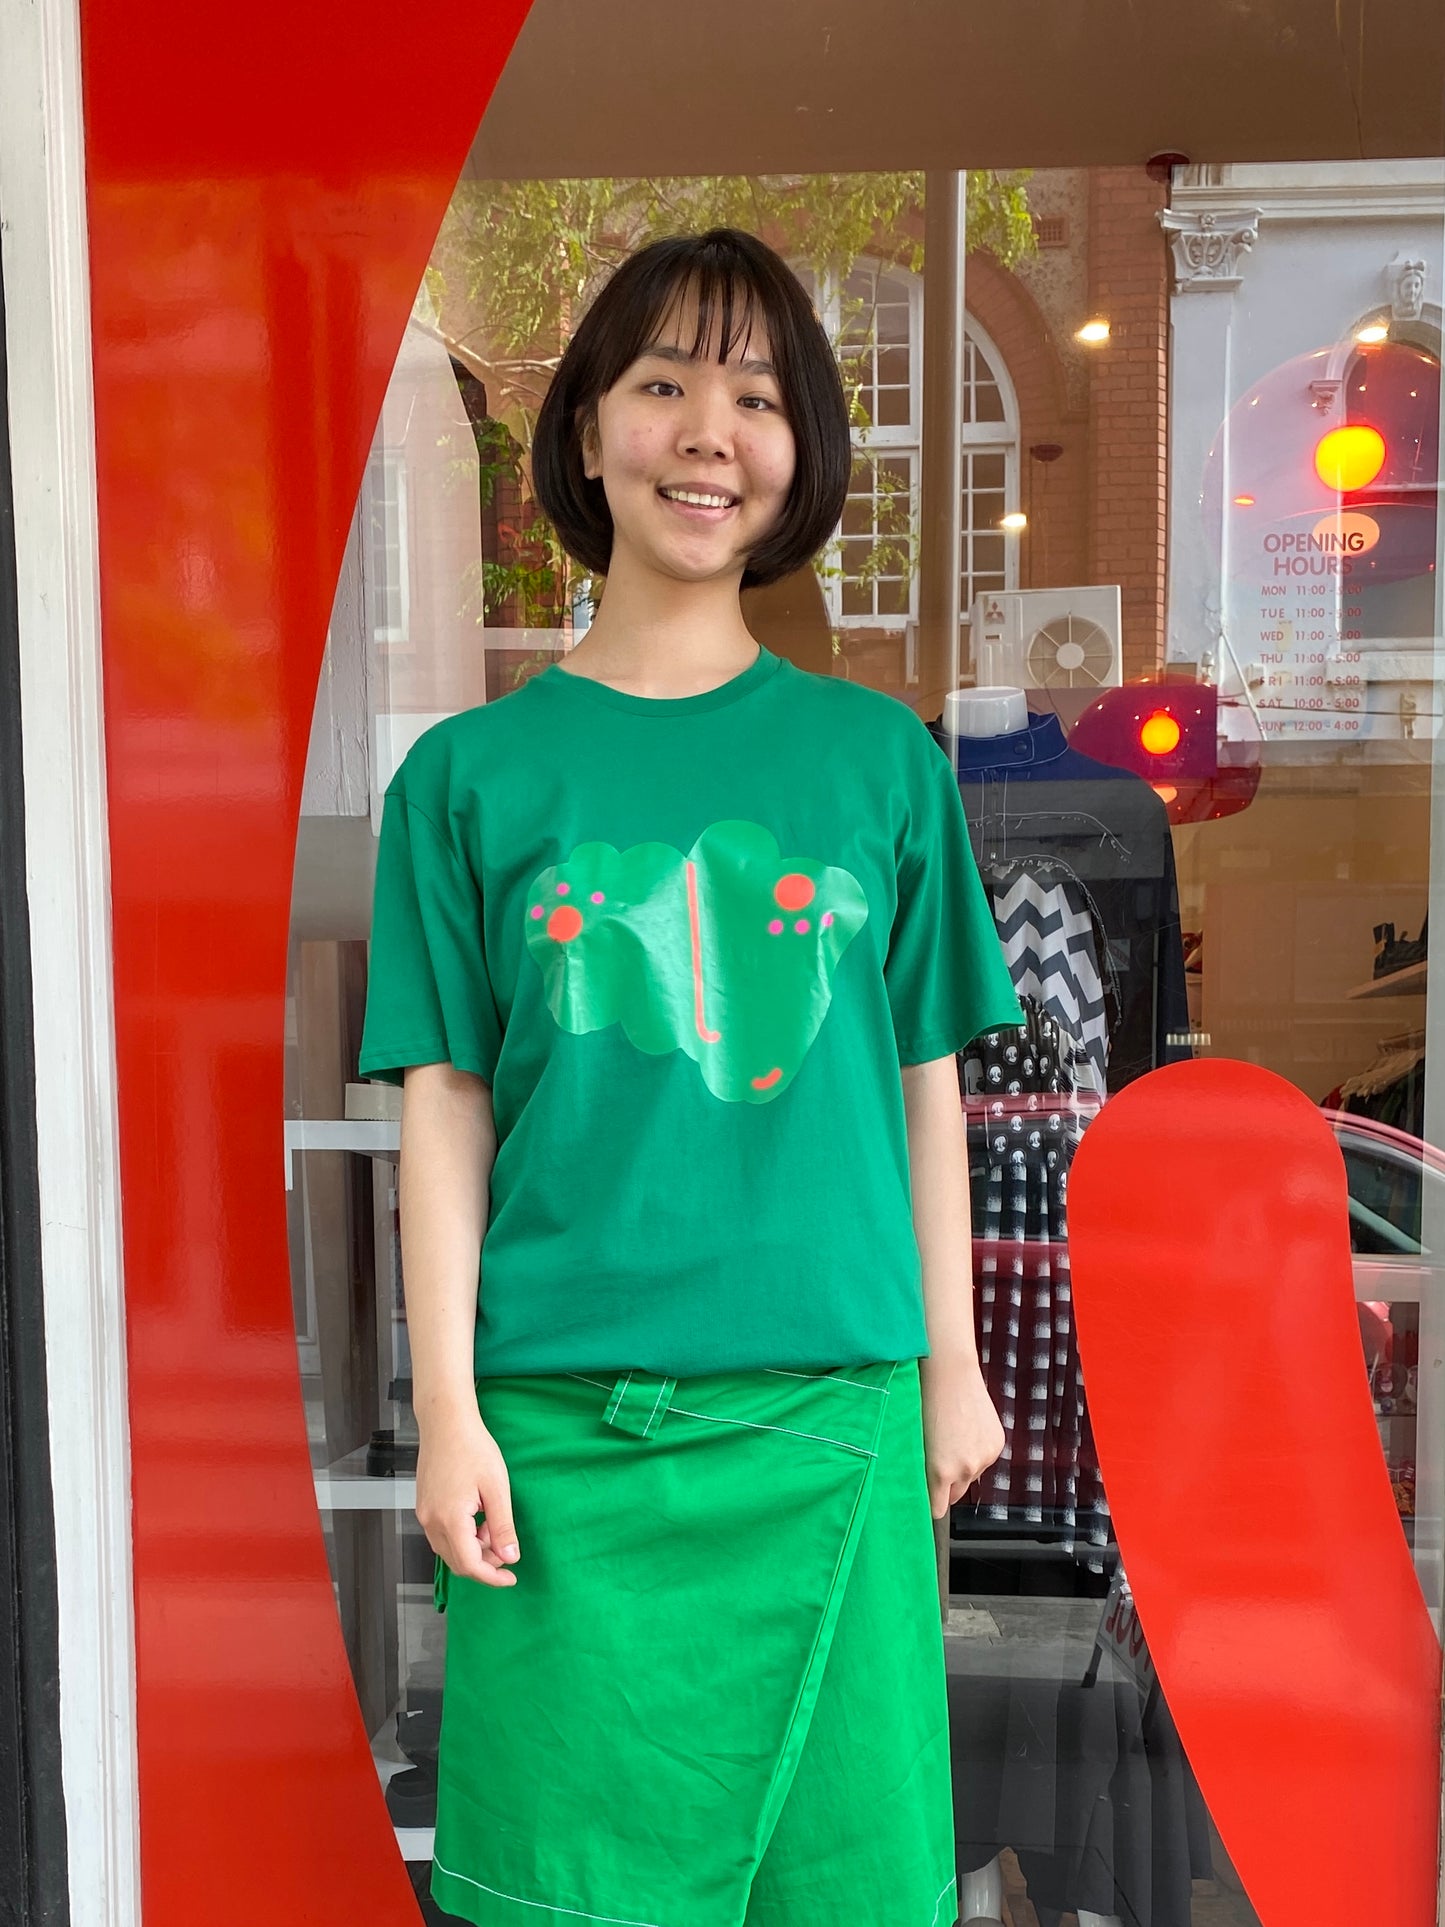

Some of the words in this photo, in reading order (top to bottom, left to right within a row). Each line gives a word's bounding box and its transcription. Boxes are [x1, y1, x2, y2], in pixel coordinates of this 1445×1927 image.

[1263, 532, 1364, 553] OPENING
[1273, 555, 1353, 576] HOURS
[1261, 585, 1287, 596] MON
[1296, 585, 1326, 596] 11:00
[1260, 608, 1285, 618] TUE
[1296, 608, 1325, 618] 11:00
[1260, 631, 1284, 641] WED
[1295, 631, 1325, 641] 11:00
[1260, 653, 1283, 664] THU
[1295, 653, 1324, 663] 11:00
[1259, 676, 1282, 686] FRI
[1294, 676, 1324, 686] 11:00
[1259, 699, 1283, 709] SAT
[1294, 699, 1323, 709] 10:00
[1334, 698, 1360, 708] 5:00
[1293, 721, 1323, 731] 12:00
[1334, 721, 1359, 730] 4:00
